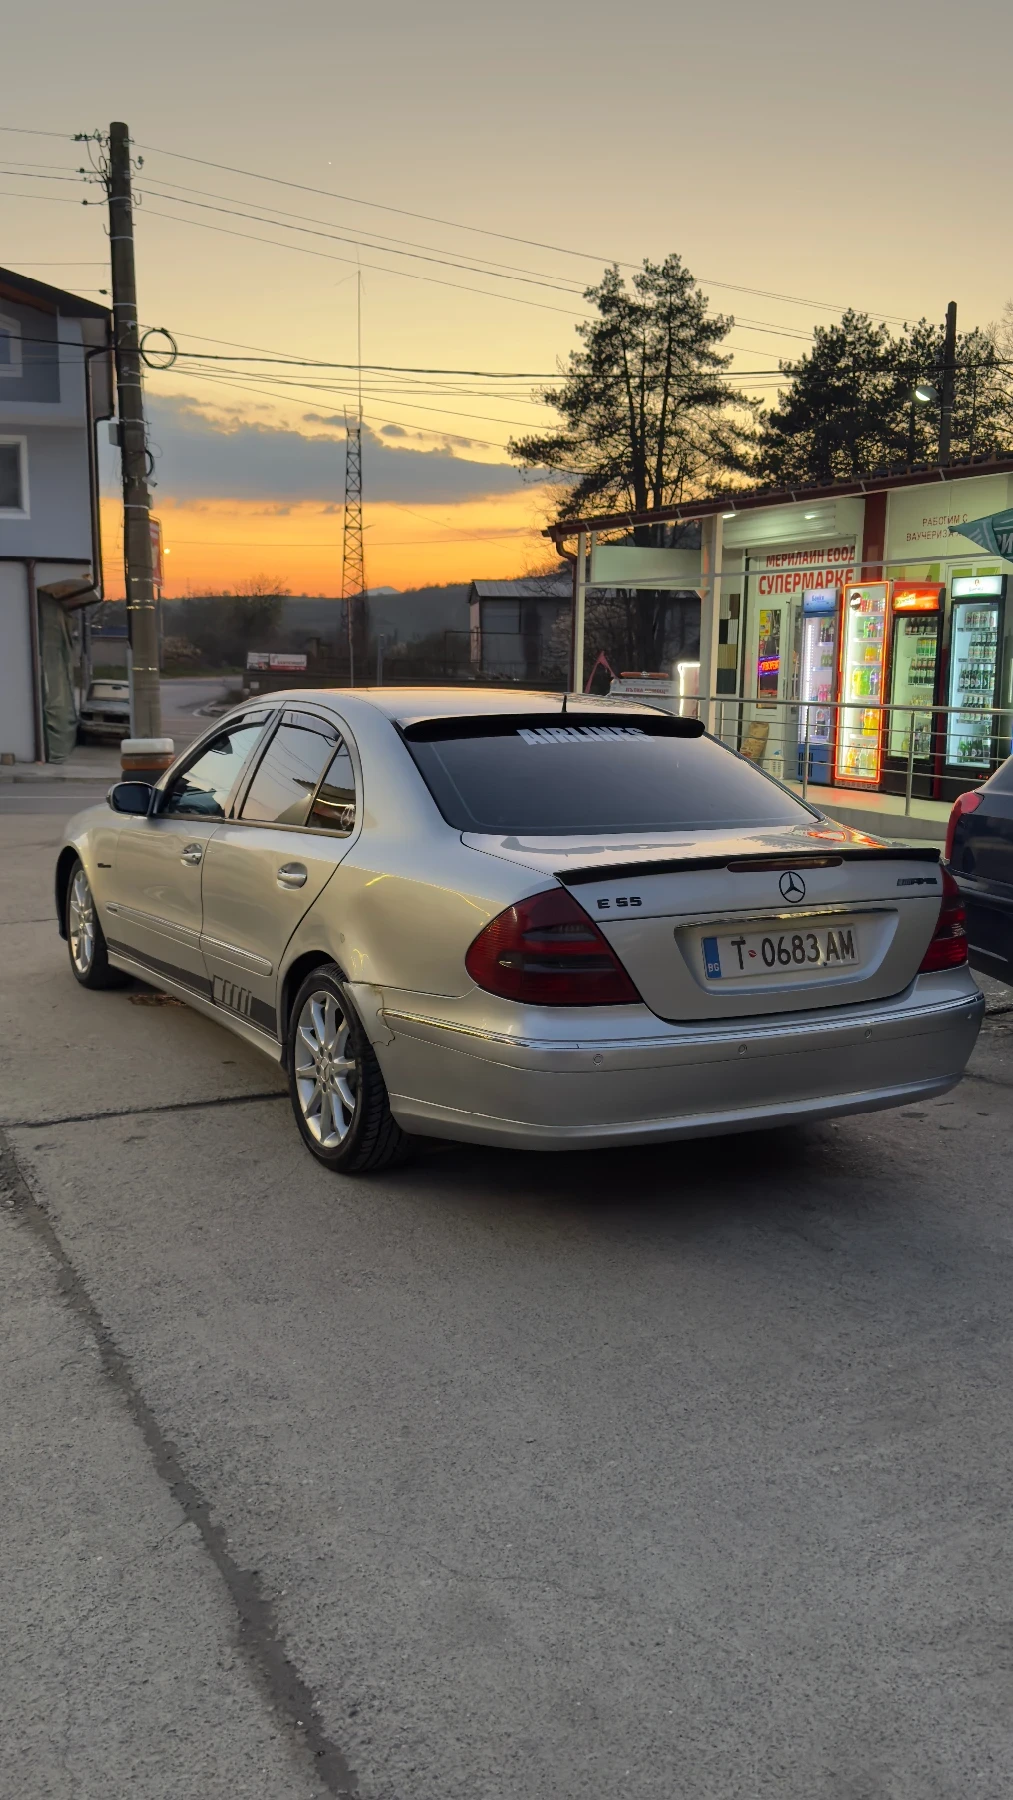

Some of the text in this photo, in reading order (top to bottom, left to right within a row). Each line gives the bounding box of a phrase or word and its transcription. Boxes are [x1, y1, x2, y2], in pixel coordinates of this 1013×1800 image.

[516, 726, 655, 746] AIRLINES
[597, 897, 642, 909] E 55
[730, 930, 855, 970] T 0683 AM
[707, 962, 720, 973] BG
